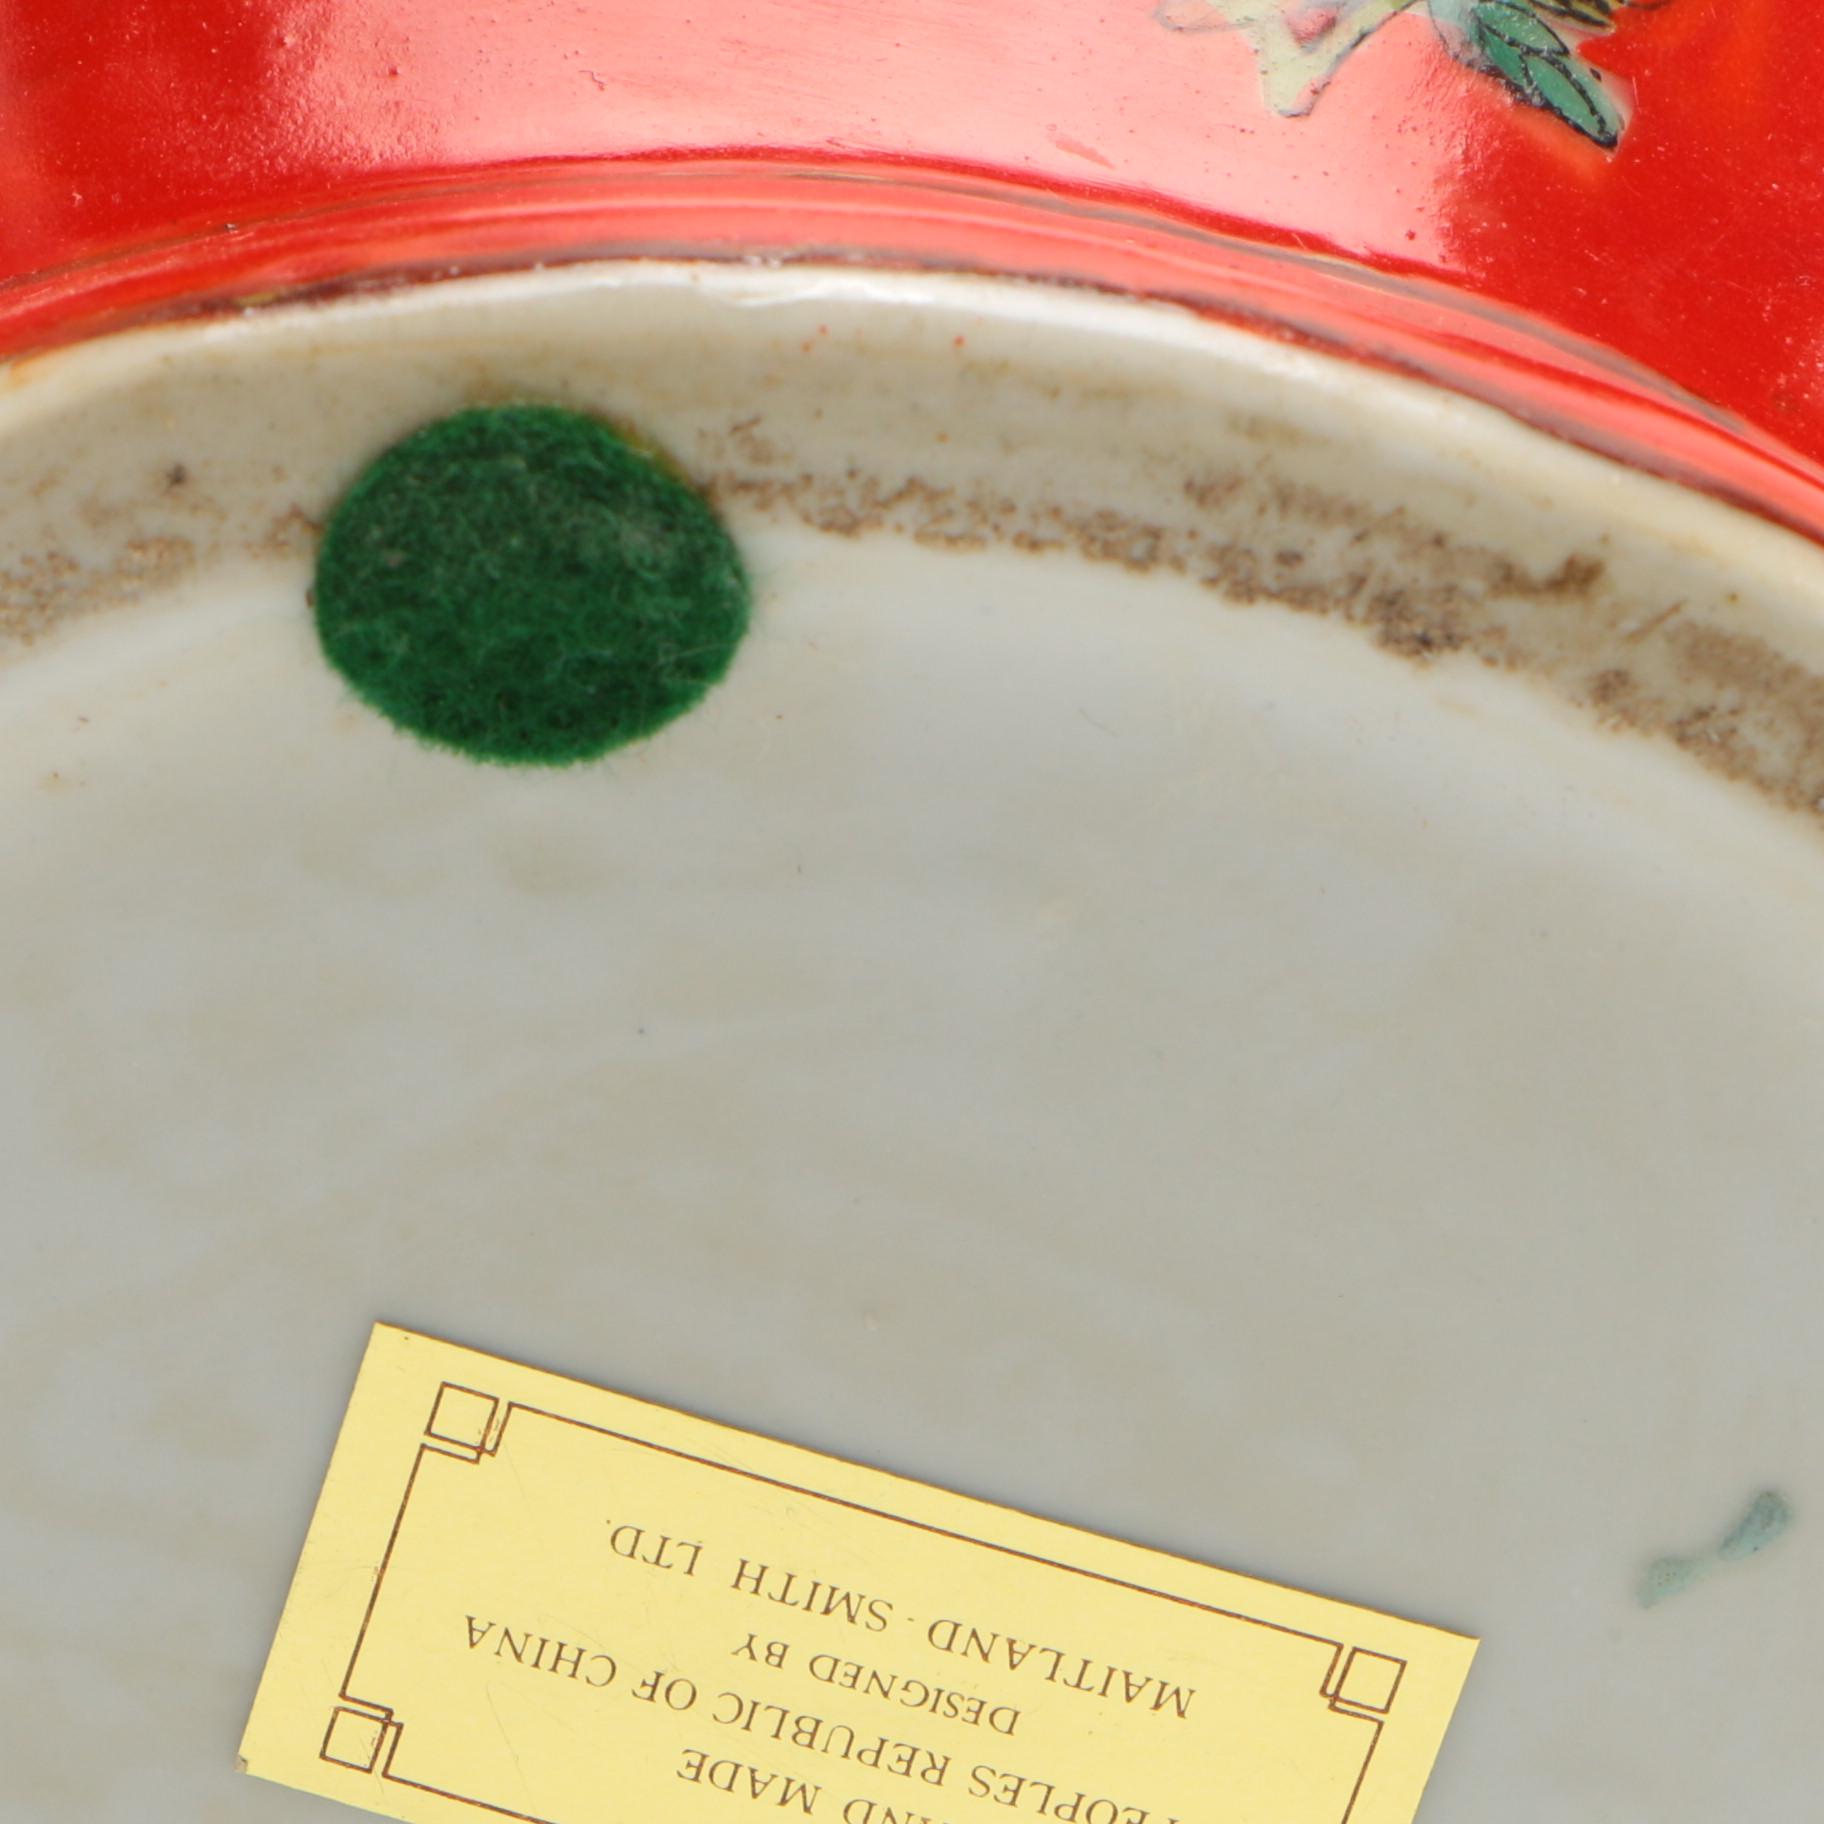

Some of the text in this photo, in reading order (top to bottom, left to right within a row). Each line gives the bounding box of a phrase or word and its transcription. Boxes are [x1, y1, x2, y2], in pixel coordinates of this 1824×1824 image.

[604, 1515, 704, 1577] LTD.
[464, 1613, 618, 1688] CHINA
[730, 1632, 1022, 1737] DESIGNED BY
[630, 1669, 698, 1712] OF
[715, 1690, 952, 1788] REPUBLIC
[675, 1747, 823, 1816] MADE
